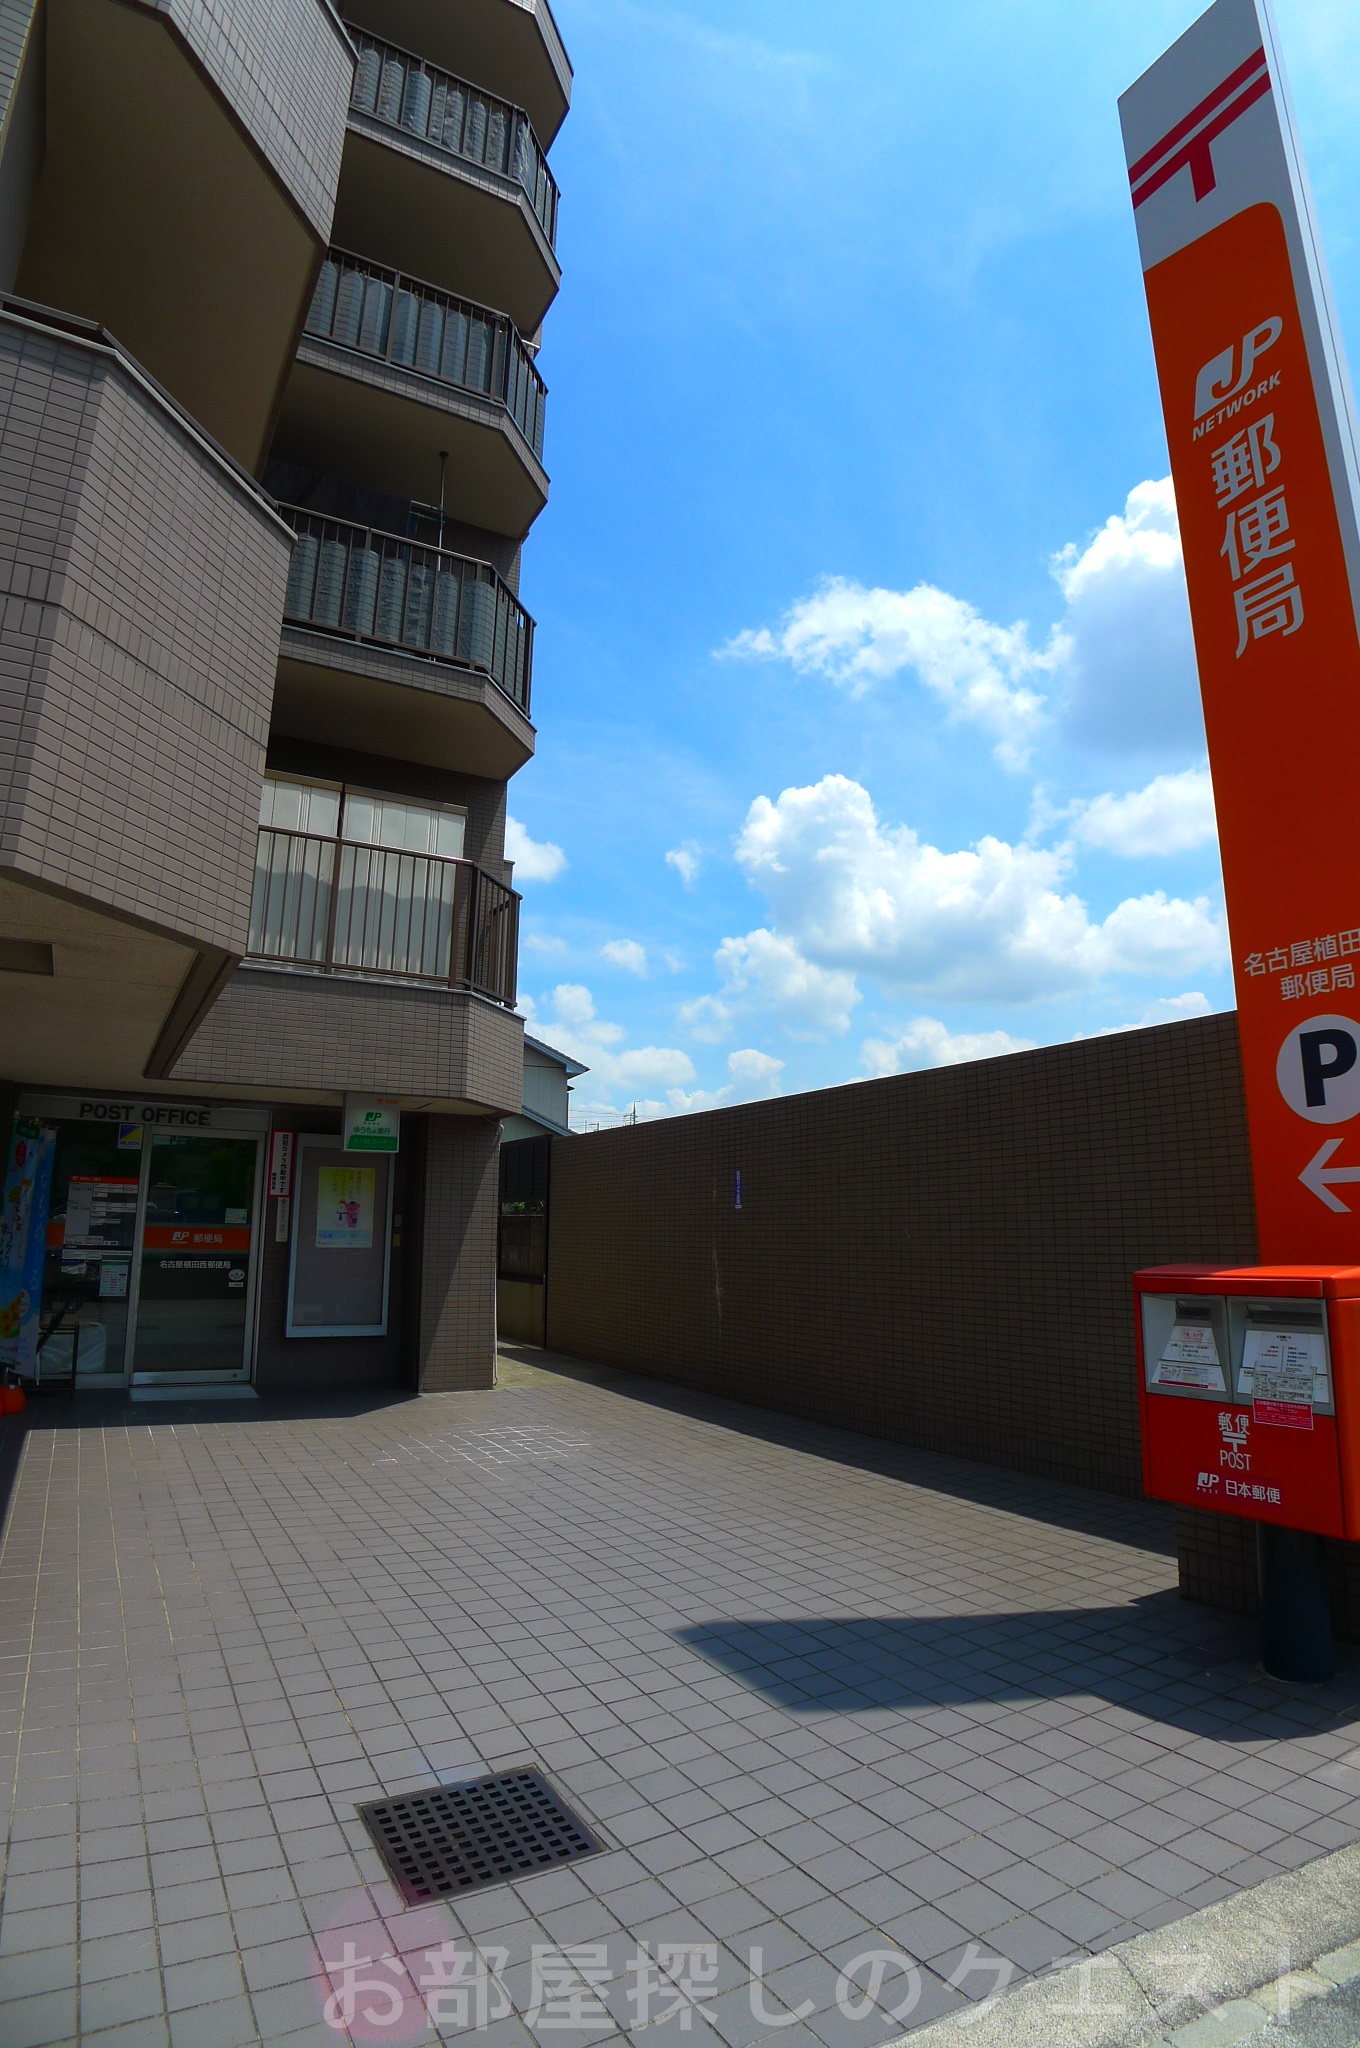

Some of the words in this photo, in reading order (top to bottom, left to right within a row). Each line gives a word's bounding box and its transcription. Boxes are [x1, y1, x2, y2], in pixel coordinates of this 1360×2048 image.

[1192, 369, 1282, 442] NETWORK
[1211, 412, 1305, 660] 郵便局
[1280, 963, 1355, 1001] 郵便局
[1299, 1028, 1357, 1107] P
[80, 1103, 134, 1122] POST
[141, 1107, 211, 1126] OFFICE
[193, 1233, 223, 1244] 郵便局
[159, 1259, 231, 1269] 名古屋植田西郵便局
[1217, 1411, 1250, 1435] 郵便
[1219, 1449, 1252, 1471] POST
[1225, 1479, 1282, 1505] 日本郵便
